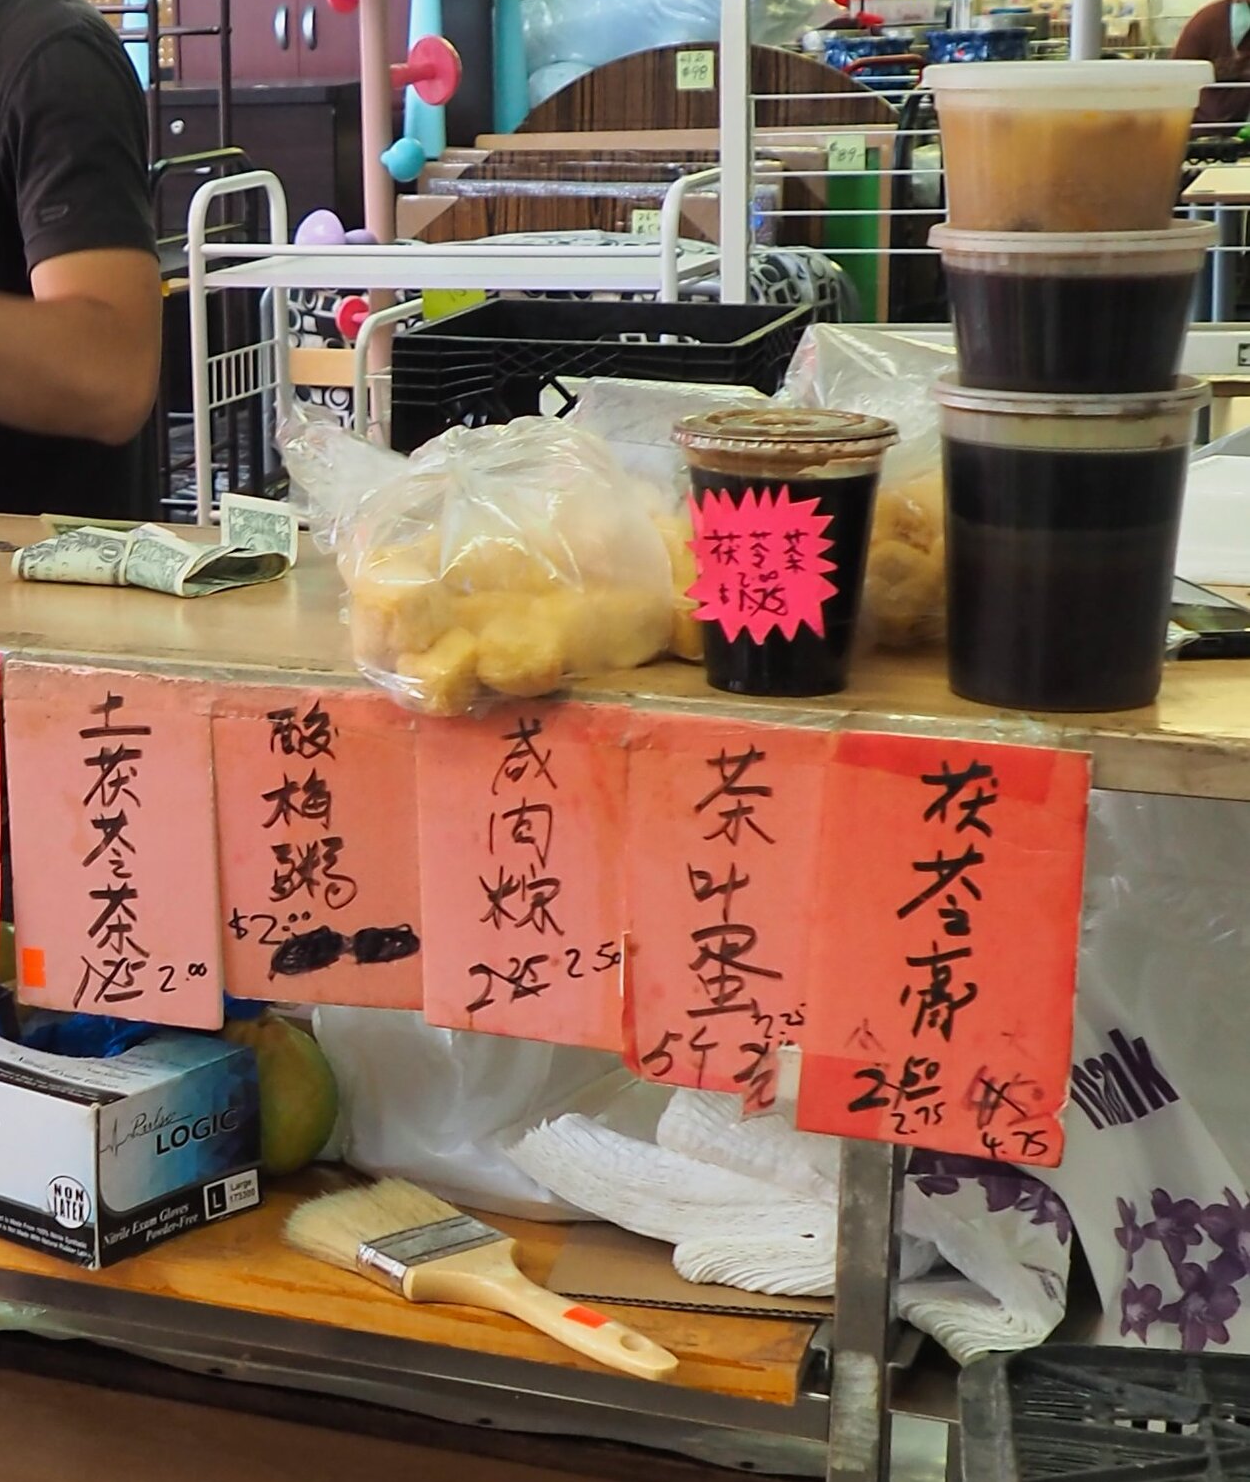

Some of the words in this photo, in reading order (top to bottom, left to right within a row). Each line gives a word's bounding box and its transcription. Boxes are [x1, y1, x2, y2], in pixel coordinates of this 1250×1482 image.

[156, 1108, 238, 1156] LOGIC
[53, 1183, 84, 1202] NON
[212, 1192, 222, 1209] L
[53, 1196, 84, 1222] LATEX
[131, 1215, 158, 1235] Exam
[159, 1203, 190, 1222] Gloves
